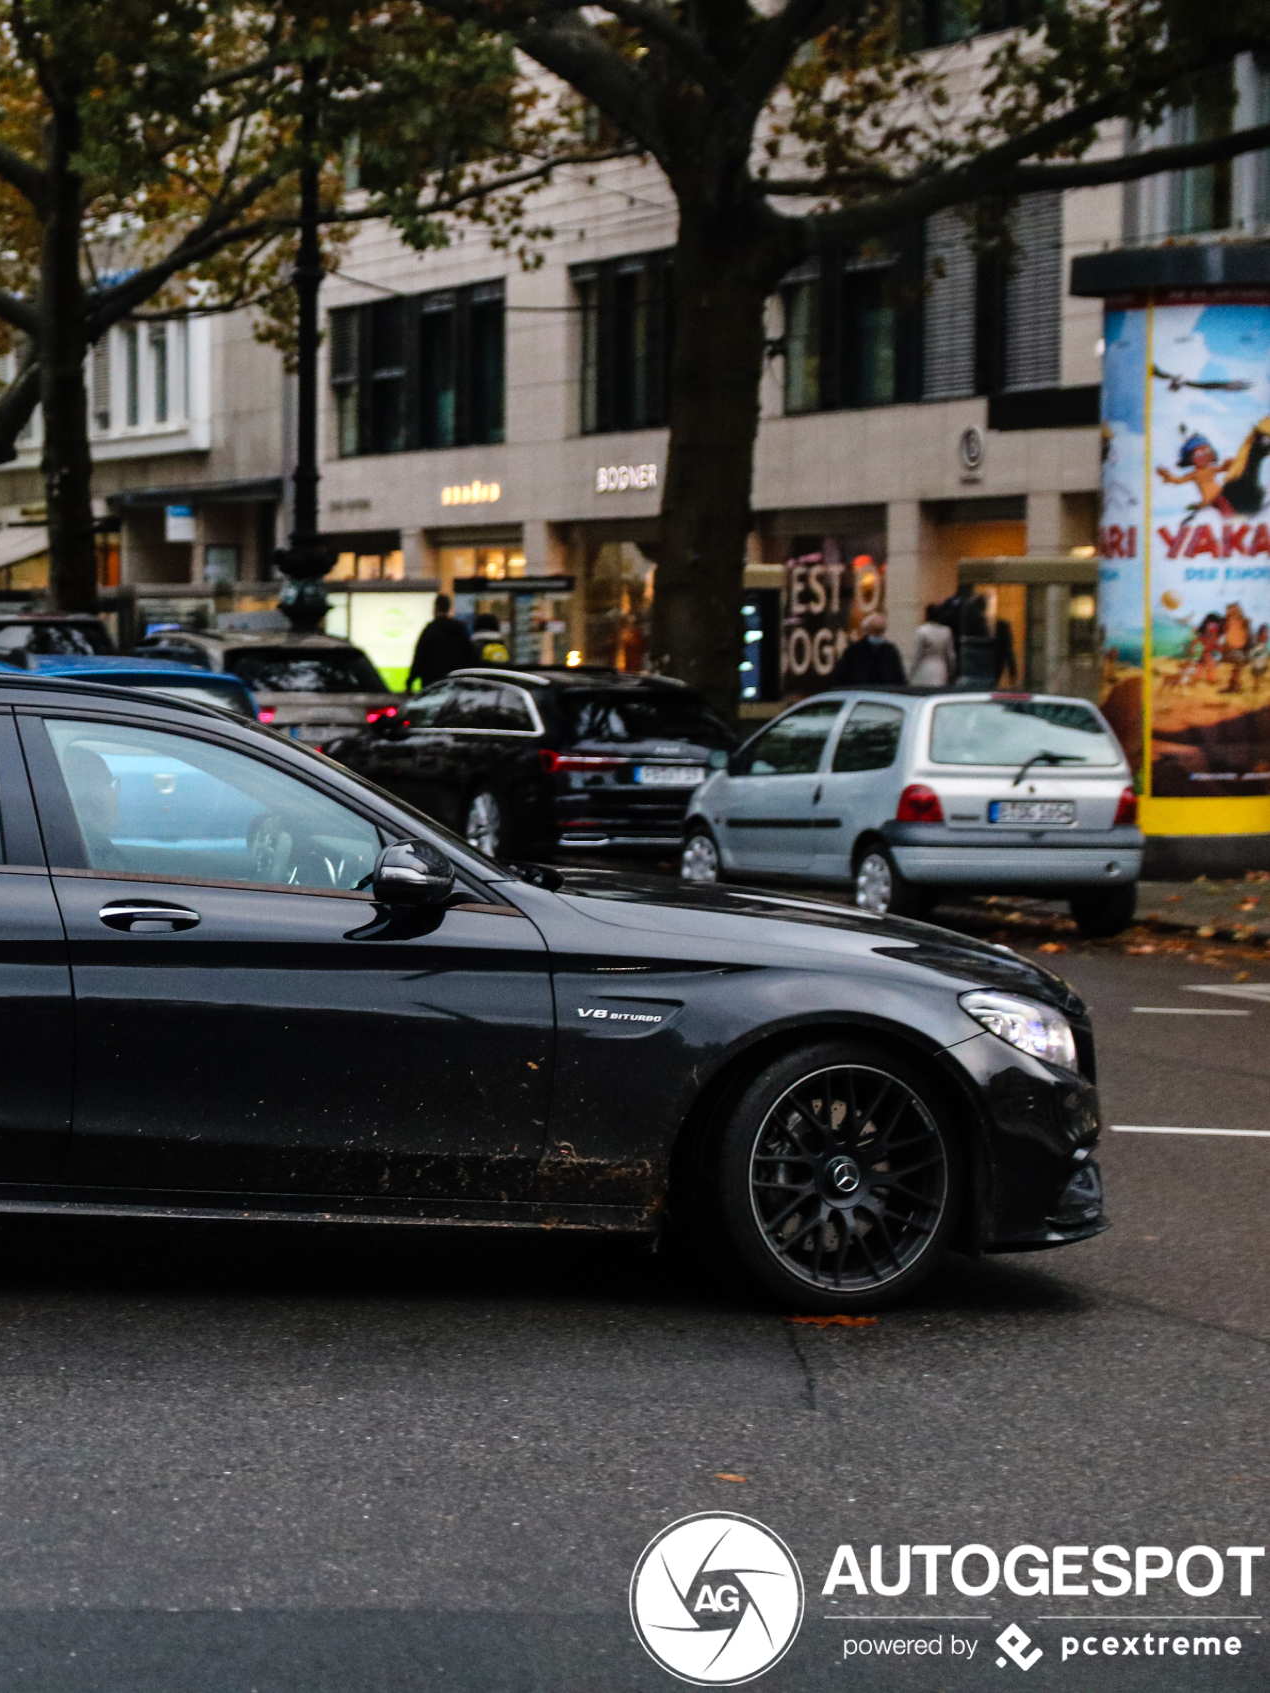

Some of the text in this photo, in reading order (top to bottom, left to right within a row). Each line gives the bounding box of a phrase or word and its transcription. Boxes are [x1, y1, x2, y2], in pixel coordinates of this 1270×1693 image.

[596, 464, 658, 492] BOGNER
[783, 564, 846, 614] EST
[577, 1008, 662, 1022] V8 BITURBO
